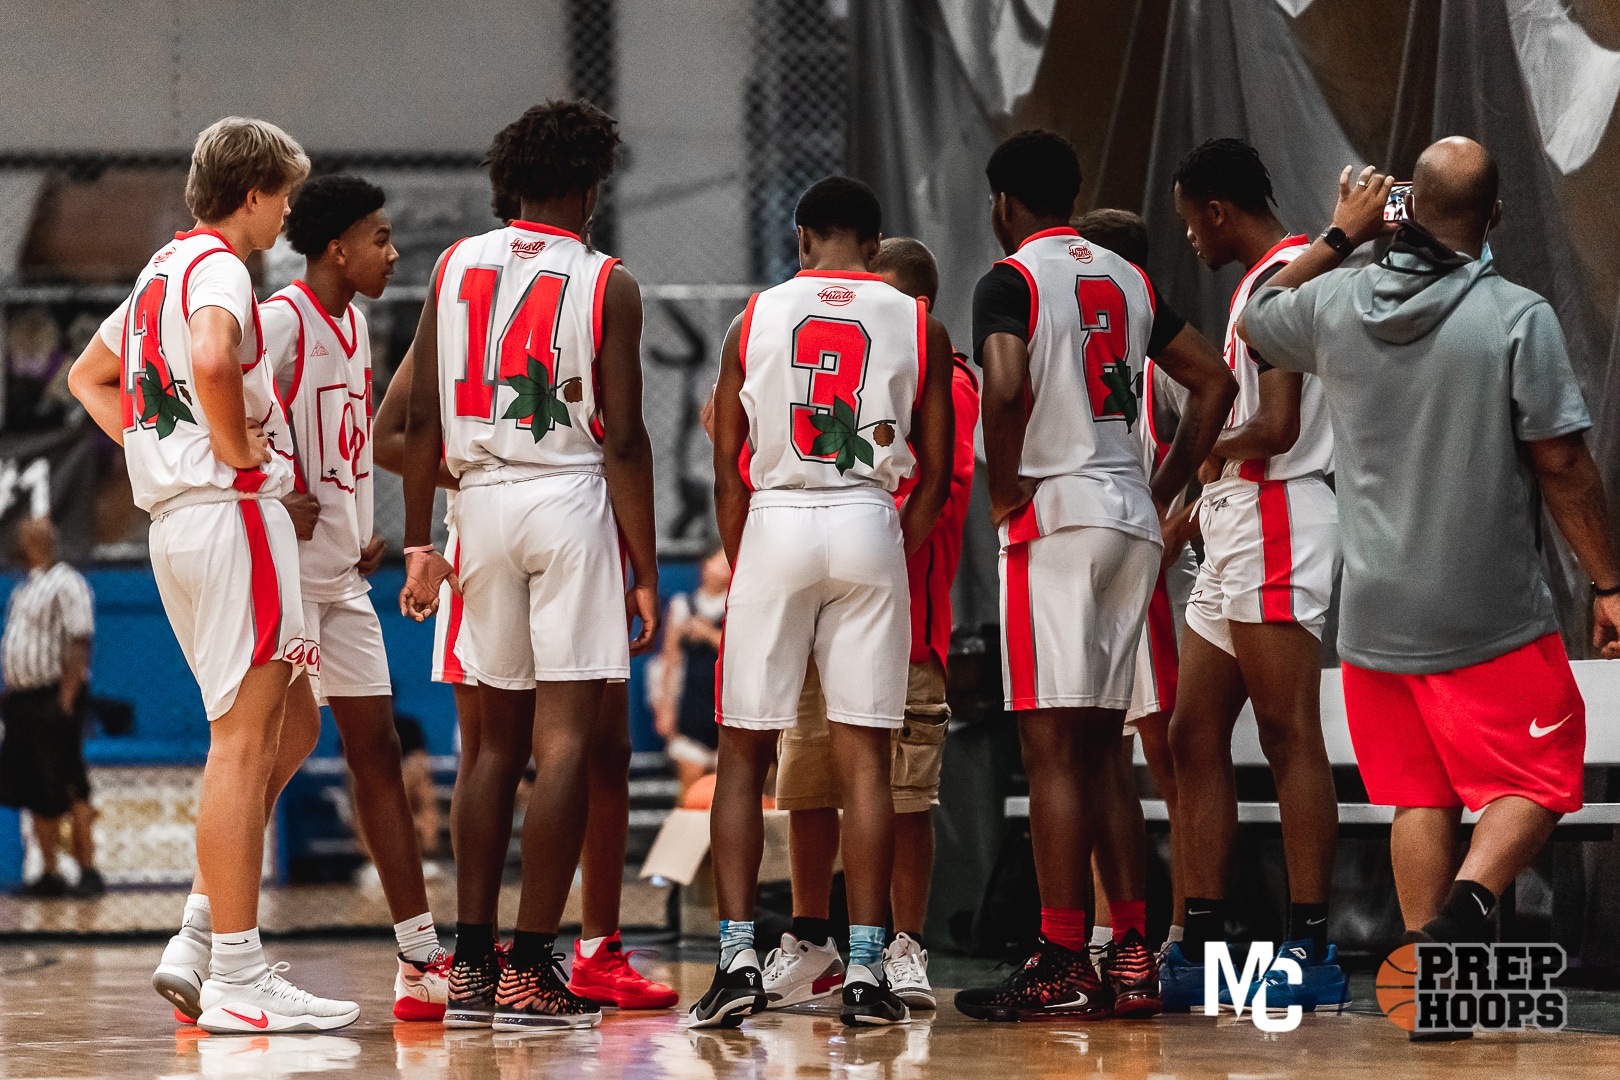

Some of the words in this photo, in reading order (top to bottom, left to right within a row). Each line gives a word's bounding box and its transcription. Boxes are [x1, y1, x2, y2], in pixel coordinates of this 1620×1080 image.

[455, 264, 570, 431] 14
[817, 290, 856, 302] Hustle
[1075, 275, 1131, 422] 2
[791, 315, 872, 464] 3
